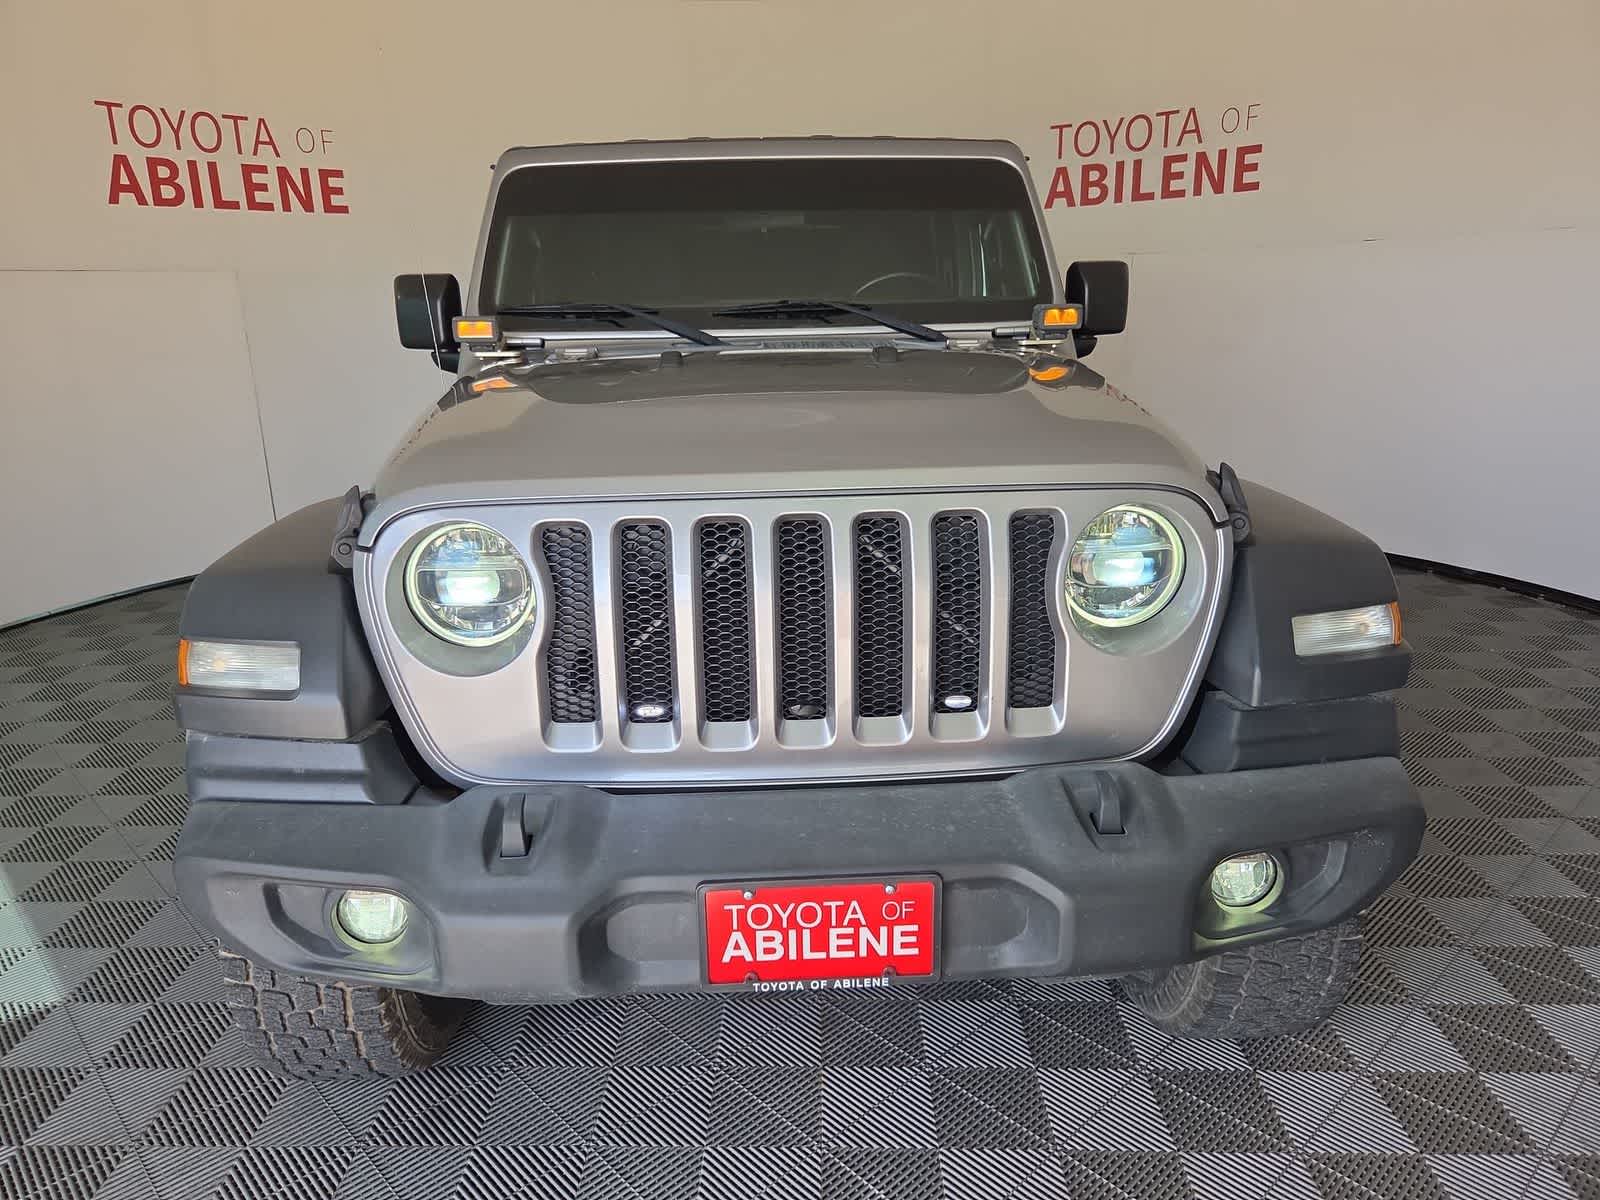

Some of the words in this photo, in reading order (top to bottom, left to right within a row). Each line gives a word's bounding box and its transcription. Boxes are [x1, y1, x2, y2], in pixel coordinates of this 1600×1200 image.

[94, 100, 281, 158] TOYOTA
[295, 127, 333, 154] OF
[1050, 107, 1203, 159] TOYOTA
[1221, 103, 1261, 133] OF
[108, 154, 350, 214] ABILENE
[1044, 144, 1263, 209] ABILENE
[723, 900, 866, 930] TOYOTA
[881, 901, 916, 920] OF
[721, 924, 919, 963] ABILENE
[753, 981, 805, 993] TOYOTA
[810, 979, 828, 990] OF
[833, 977, 890, 989] ABILENE
